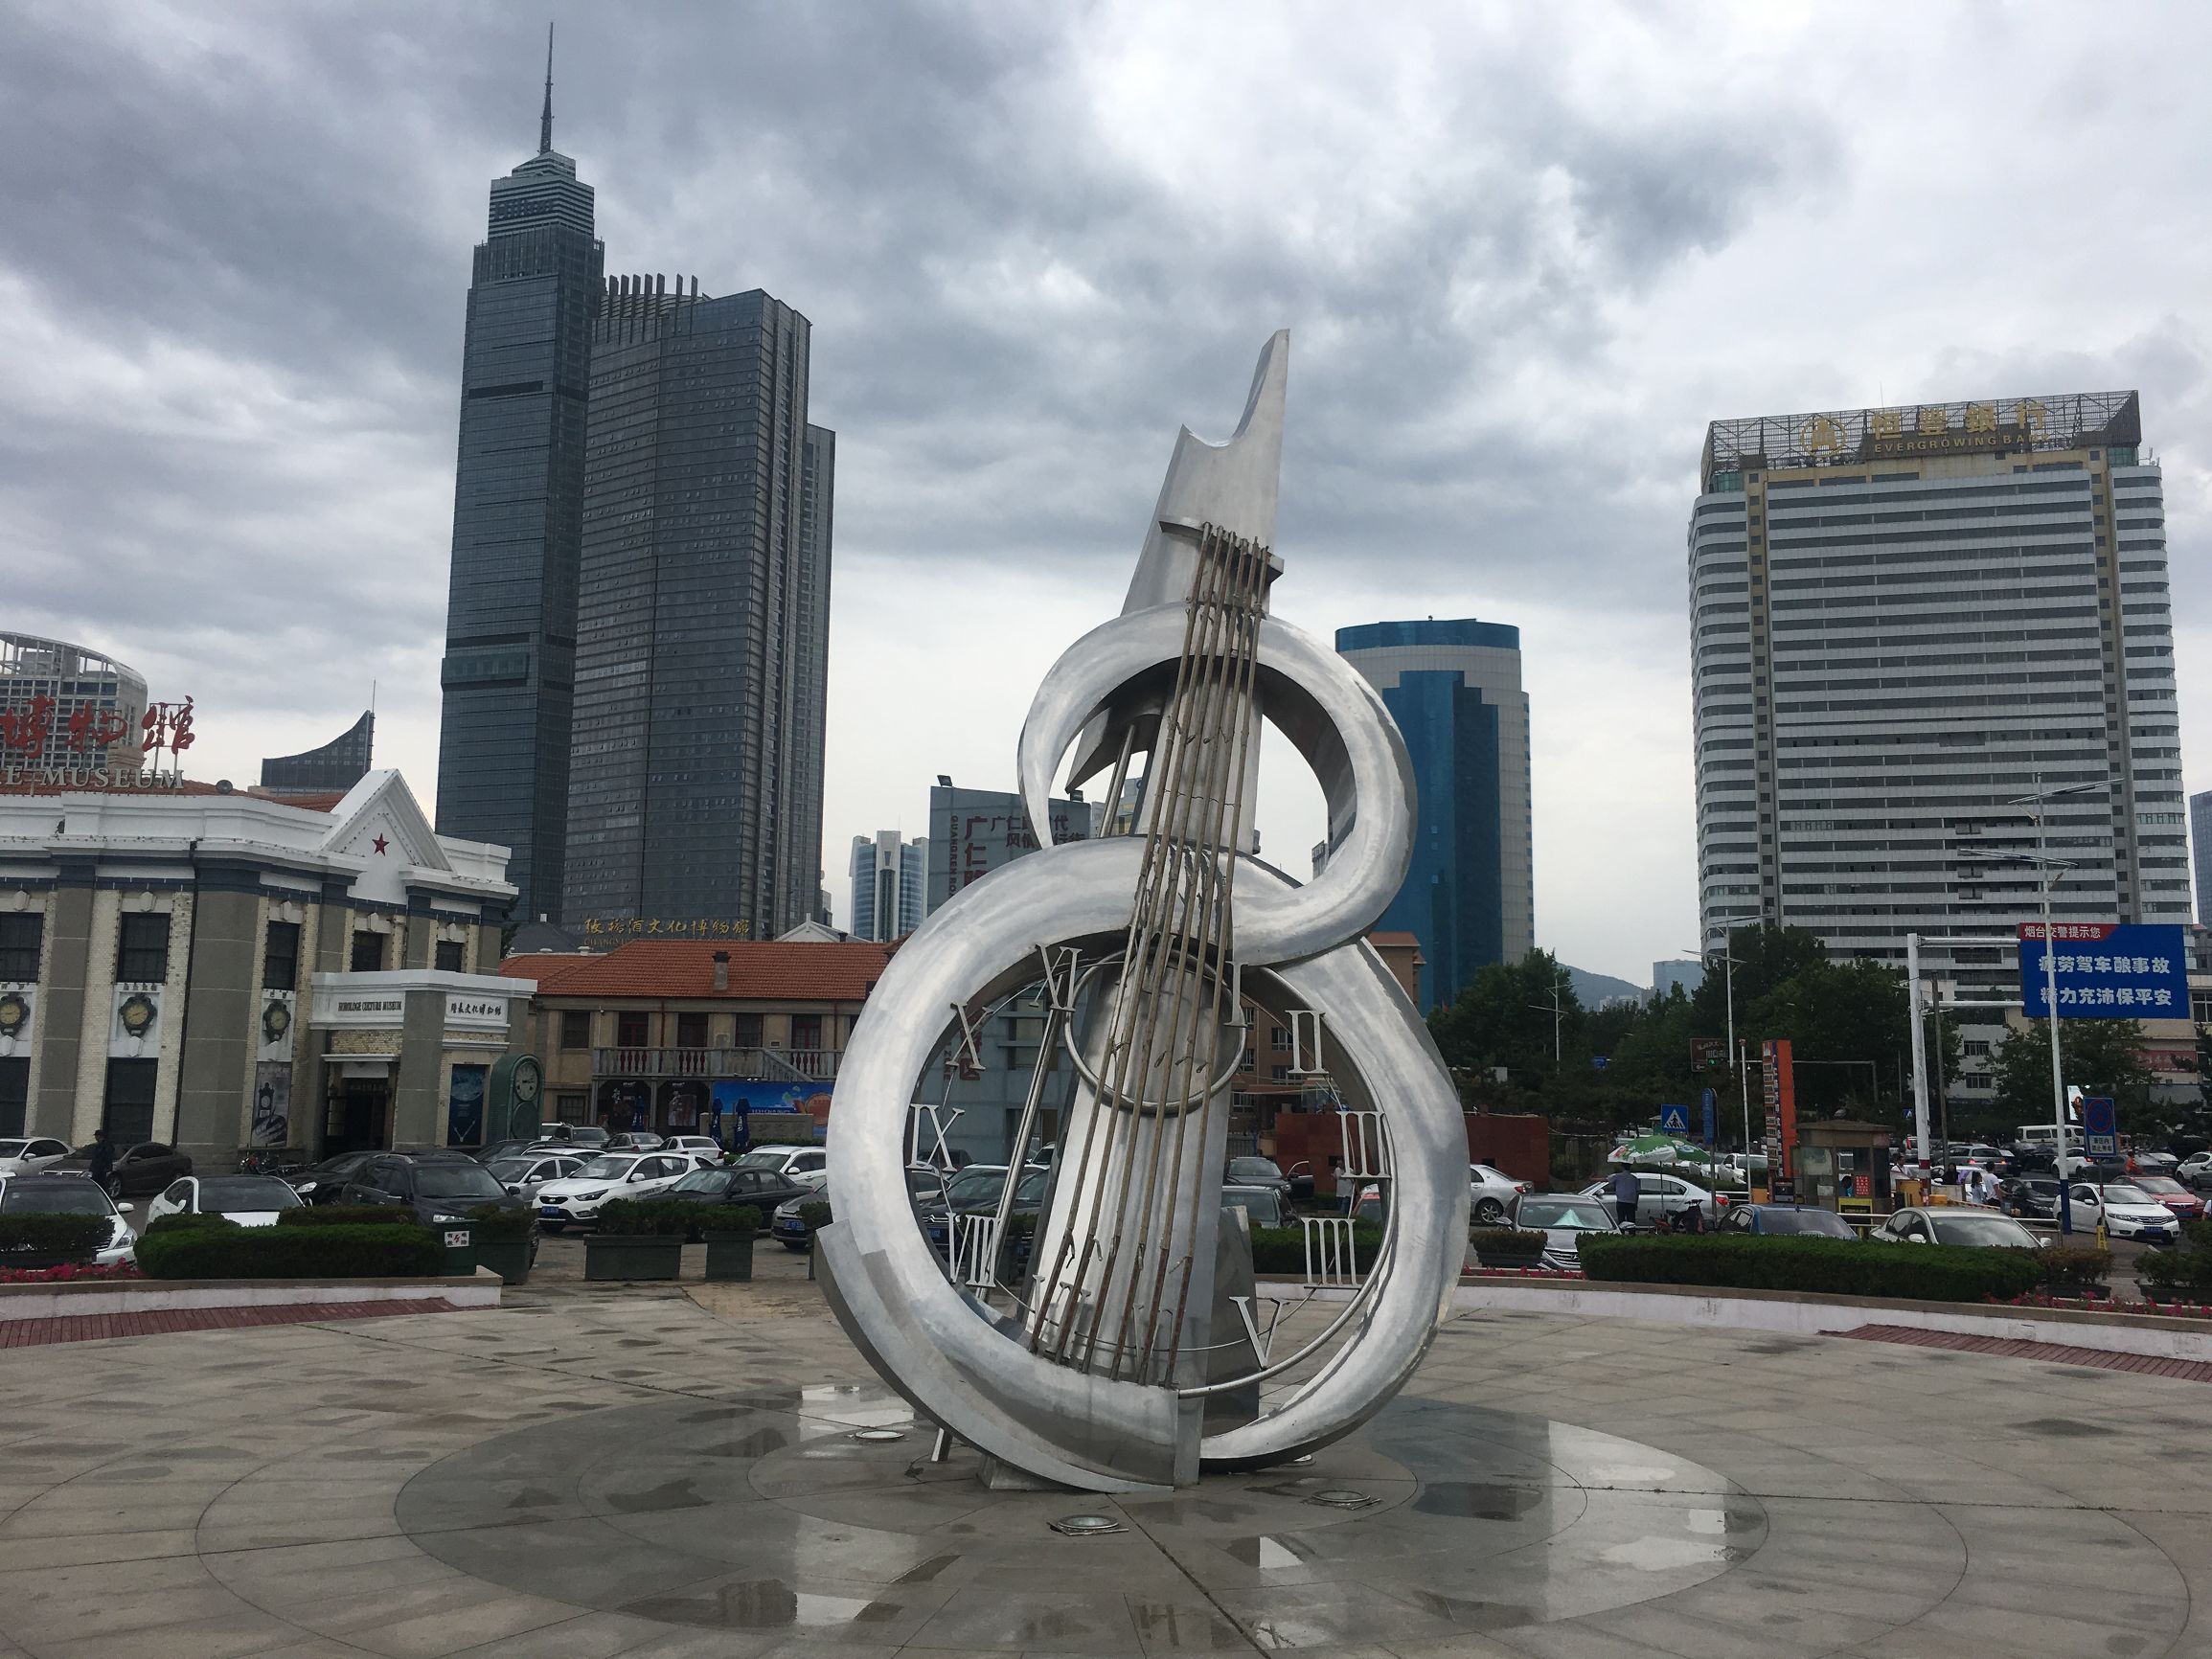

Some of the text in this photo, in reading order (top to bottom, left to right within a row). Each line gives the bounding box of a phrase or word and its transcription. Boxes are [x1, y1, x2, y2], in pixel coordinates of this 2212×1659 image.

[1875, 435, 1996, 453] EVERGROWING
[40, 765, 185, 789] MUSEUM
[2024, 925, 2101, 939] 烟台交警提示您
[2040, 987, 2172, 1006] 精力充沛保平安
[1285, 1010, 1329, 1074] II
[905, 1103, 966, 1172] IX
[1335, 1111, 1392, 1179] III
[1229, 1296, 1290, 1371] V
